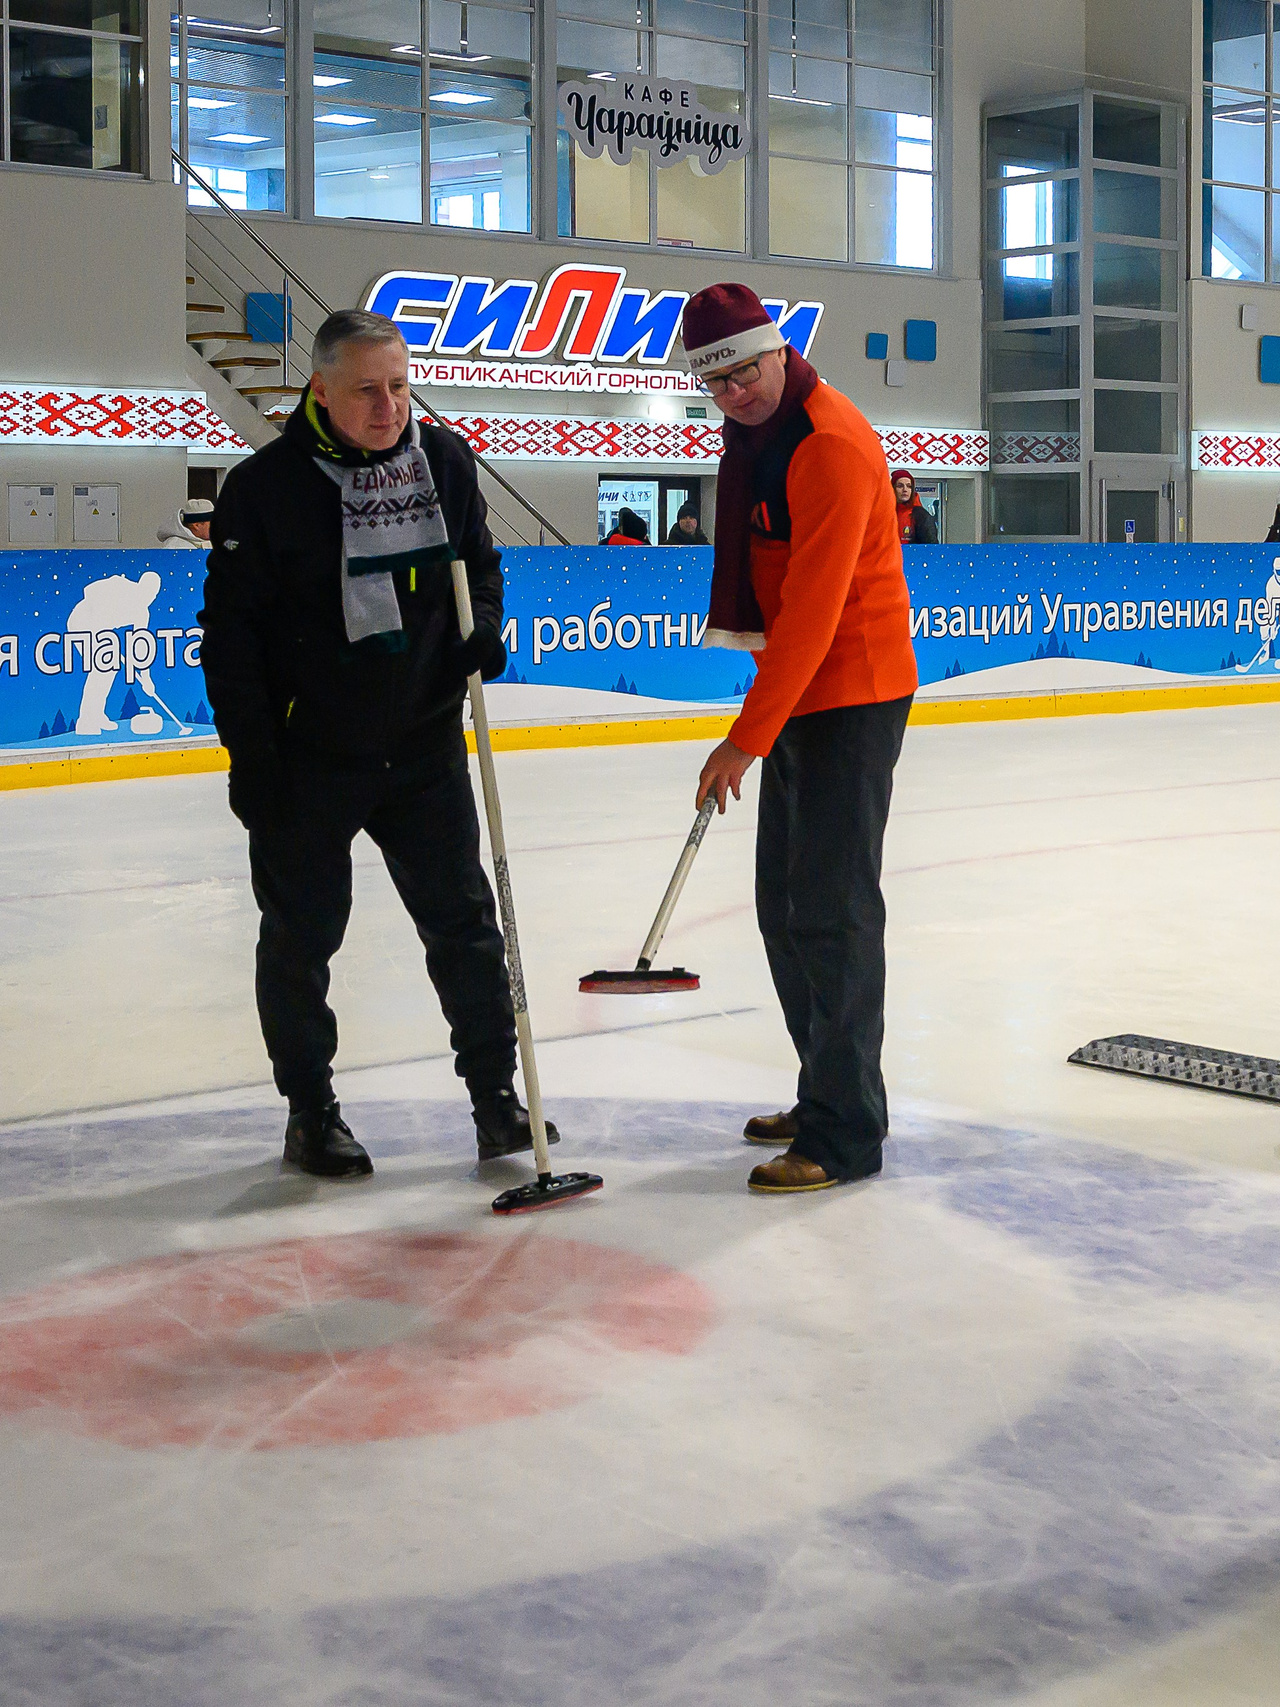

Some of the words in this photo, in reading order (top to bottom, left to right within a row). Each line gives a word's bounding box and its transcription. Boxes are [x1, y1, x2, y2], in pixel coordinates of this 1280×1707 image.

[624, 82, 690, 108] КАФЕ
[567, 91, 743, 165] Чараўніца
[369, 266, 822, 361] СИЛИИ
[409, 363, 592, 387] ПУБЛИКАНСКИЙ
[597, 371, 698, 392] ГОРНОЛЫ
[353, 461, 424, 494] ЕДИНЫЕ
[598, 491, 619, 502] ИЧИ
[34, 627, 205, 684] спарта
[500, 615, 518, 653] и
[532, 600, 710, 665] работни
[908, 593, 1033, 644] изаций
[1040, 592, 1228, 643] Управления
